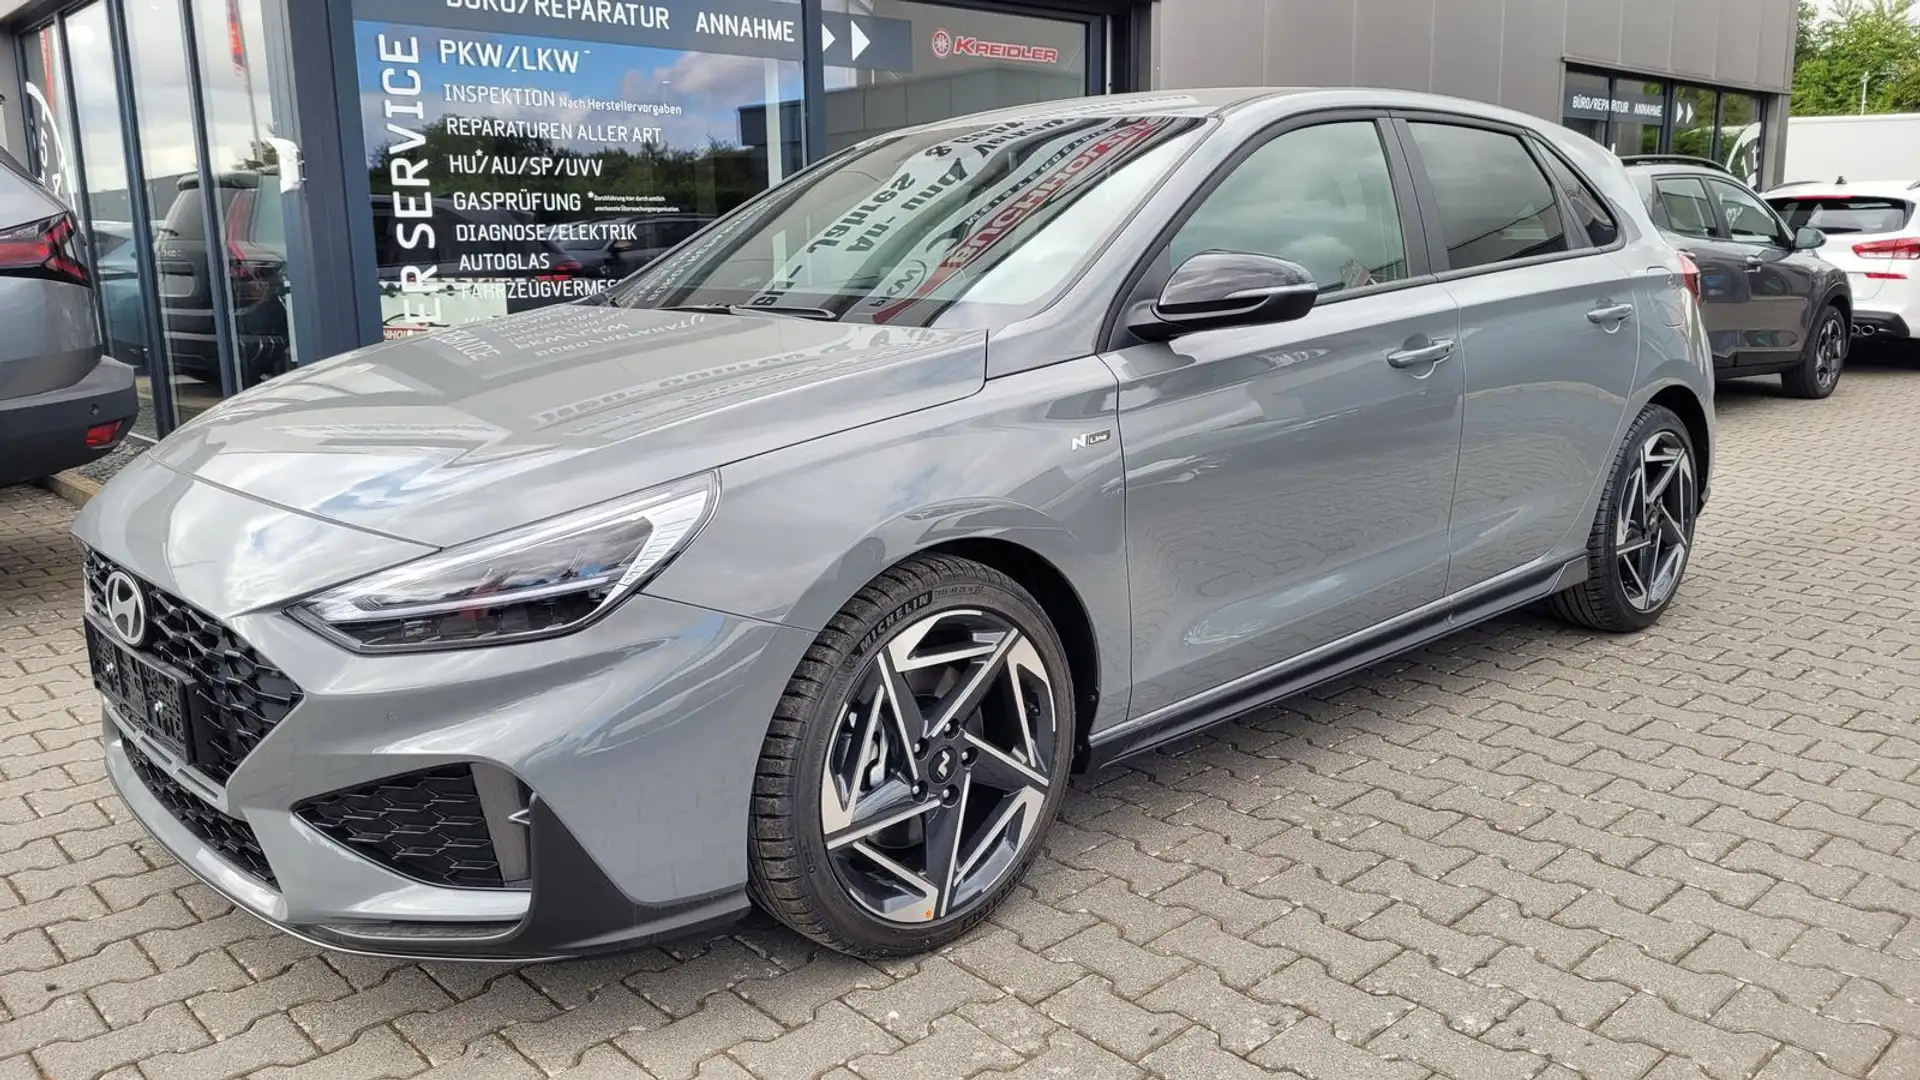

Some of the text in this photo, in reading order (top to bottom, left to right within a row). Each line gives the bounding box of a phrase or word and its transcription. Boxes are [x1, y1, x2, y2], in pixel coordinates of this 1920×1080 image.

[696, 11, 796, 43] ANNAHME
[440, 39, 579, 73] PKW/LKW
[954, 36, 1058, 63] KREIDLER
[443, 84, 683, 117] INSPEKTION Nach Herstellervorgaben
[378, 33, 436, 249] SERVICE
[446, 117, 662, 143] REPARATUREN ALLER ART
[454, 189, 581, 212] GASPRÜFUNG
[456, 224, 638, 242] DIAGNOSE/ELEKTRIK
[459, 252, 550, 271] AUTOGLAS
[460, 279, 624, 300] FAHRZEUGVERMES
[860, 593, 930, 653] MICHELIN
